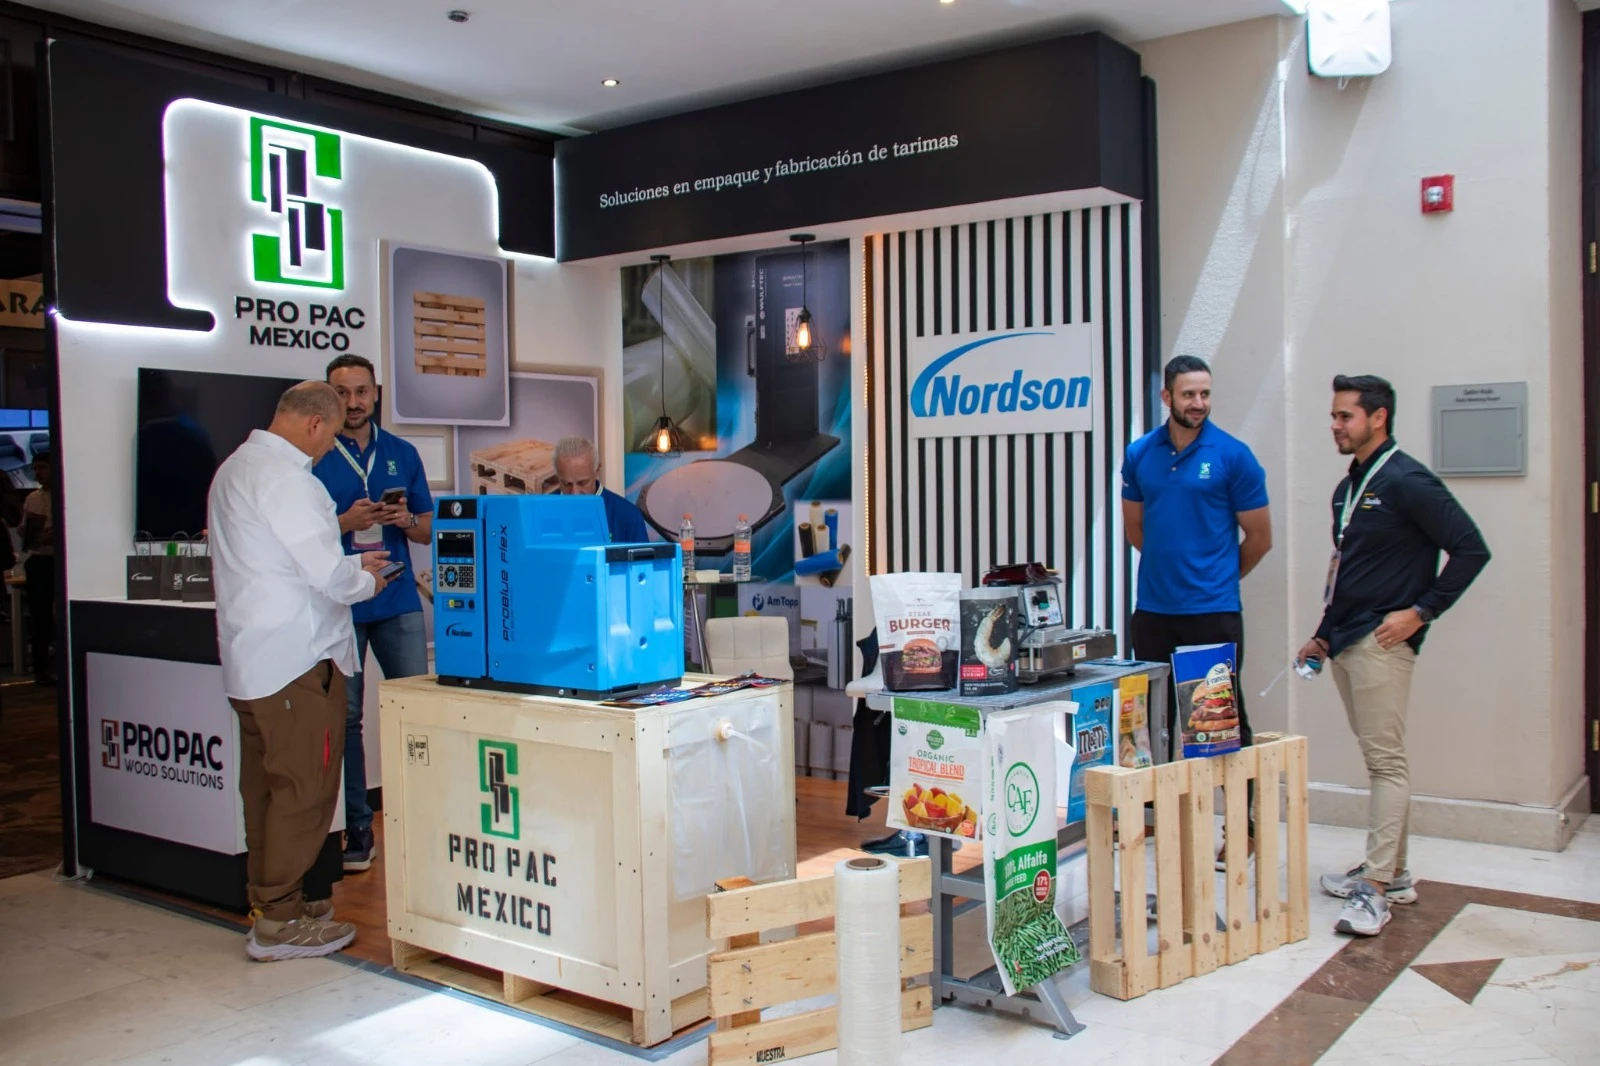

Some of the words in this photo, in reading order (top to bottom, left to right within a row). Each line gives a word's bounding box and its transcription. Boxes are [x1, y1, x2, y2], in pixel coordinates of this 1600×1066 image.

[600, 186, 669, 208] Soluciones
[673, 181, 690, 195] en
[694, 168, 760, 192] empaque
[764, 166, 773, 183] y
[775, 150, 863, 177] fabricación
[868, 144, 888, 163] de
[893, 134, 959, 158] tarimas
[235, 296, 300, 324] PRO
[309, 304, 365, 329] PAC
[250, 325, 350, 351] MEXICO
[928, 369, 1092, 417] Nordson
[767, 596, 799, 608] AmTopp
[451, 628, 473, 637] Nordson
[889, 618, 951, 632] BURGER
[122, 721, 171, 761] PRO
[174, 729, 224, 771] PAC
[917, 749, 955, 763] ORGANIC
[125, 758, 158, 777] WOOD
[161, 765, 224, 790] SOLUTIONS
[908, 757, 937, 773] TROPICAL
[940, 763, 965, 776] BLEND
[1007, 783, 1032, 815] CAF
[449, 833, 495, 873] PRO
[507, 847, 557, 887] PAC
[1017, 850, 1048, 871] Alfalfa
[457, 883, 551, 936] MEXICO
[756, 1046, 785, 1062] MUESTRA
